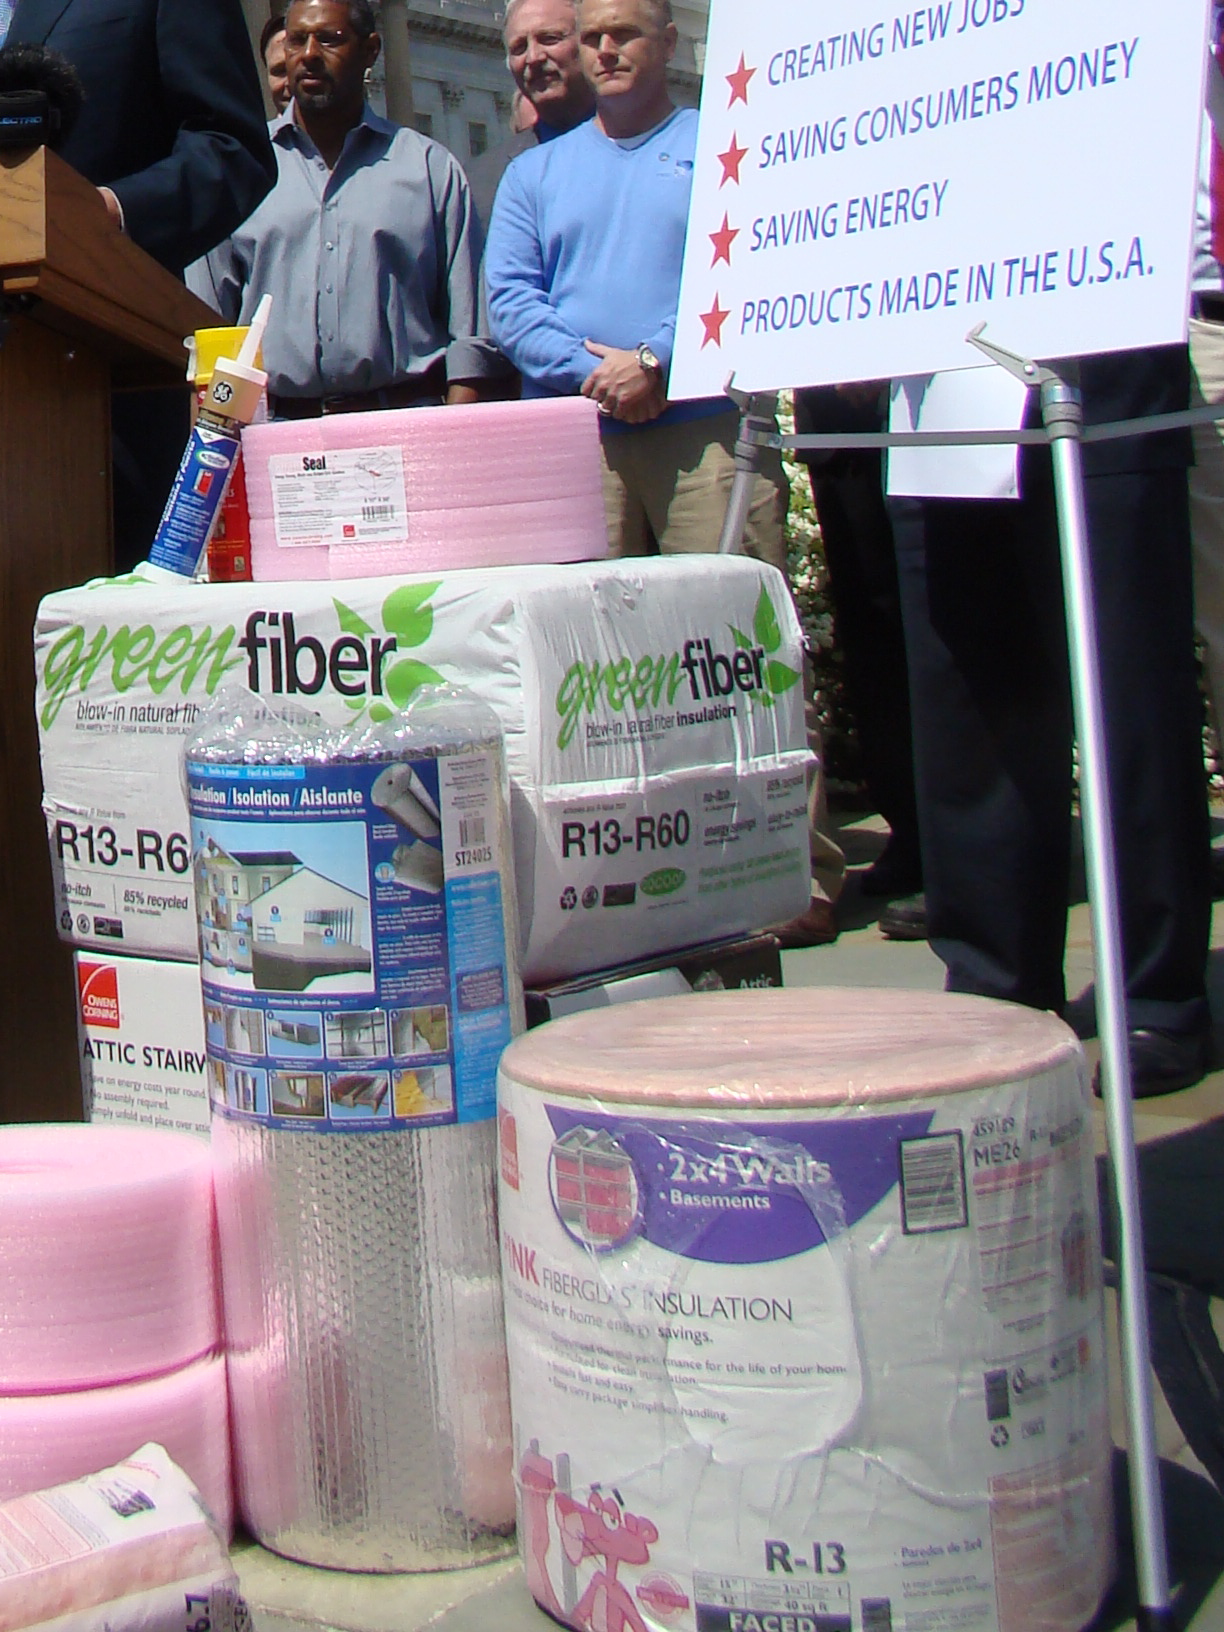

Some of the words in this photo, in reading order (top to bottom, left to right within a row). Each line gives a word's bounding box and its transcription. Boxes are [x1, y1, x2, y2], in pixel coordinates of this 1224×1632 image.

[767, 22, 884, 87] CREATING
[891, 1, 952, 53] NEW
[758, 116, 847, 169] SAVING
[854, 71, 1019, 147] CONSUMERS
[1027, 36, 1139, 105] MONEY
[750, 202, 838, 252] SAVING
[844, 178, 949, 235] ENERGY
[741, 283, 872, 335] PRODUCTS
[879, 268, 958, 316] MADE
[965, 263, 995, 302] IN
[1003, 252, 1059, 297] THE
[1067, 236, 1155, 287] U.S.A.
[302, 455, 326, 471] Seal
[76, 700, 125, 722] blow-in
[129, 702, 179, 723] natural
[586, 720, 622, 739] blow-in
[677, 704, 736, 727] insulation
[232, 787, 289, 806] Isolation
[300, 786, 363, 806] Aislante
[55, 819, 190, 874] R13-R6
[562, 809, 689, 858] R13-R60
[61, 882, 91, 897] no-itch
[123, 889, 145, 905] 85%
[147, 894, 188, 910] recycled
[83, 1005, 118, 1020] CORNING
[88, 994, 117, 1009] OWENS
[83, 1038, 136, 1064] ATTIC
[143, 1046, 206, 1074] STAIR
[104, 1092, 134, 1107] assembly
[118, 1078, 141, 1091] energy
[144, 1082, 162, 1092] costs
[116, 1111, 137, 1121] unfold
[140, 1113, 153, 1123] and
[155, 1115, 174, 1128] place
[176, 1120, 192, 1130] over
[669, 1152, 727, 1183] 2x4
[729, 1152, 830, 1185] Walls
[974, 1142, 1020, 1167] ME26
[670, 1188, 770, 1209] Basements
[643, 1283, 792, 1322] INSULATION
[552, 1300, 567, 1318] for
[570, 1309, 603, 1327] home
[658, 1324, 714, 1347] savings.
[705, 1359, 721, 1371] for
[726, 1360, 744, 1373] the
[748, 1359, 766, 1374] life
[770, 1361, 782, 1374] of
[786, 1364, 811, 1375] your
[592, 1391, 629, 1410] package
[681, 1405, 728, 1423] handling.
[764, 1539, 848, 1574] R-13
[729, 1611, 815, 1632] FACED
